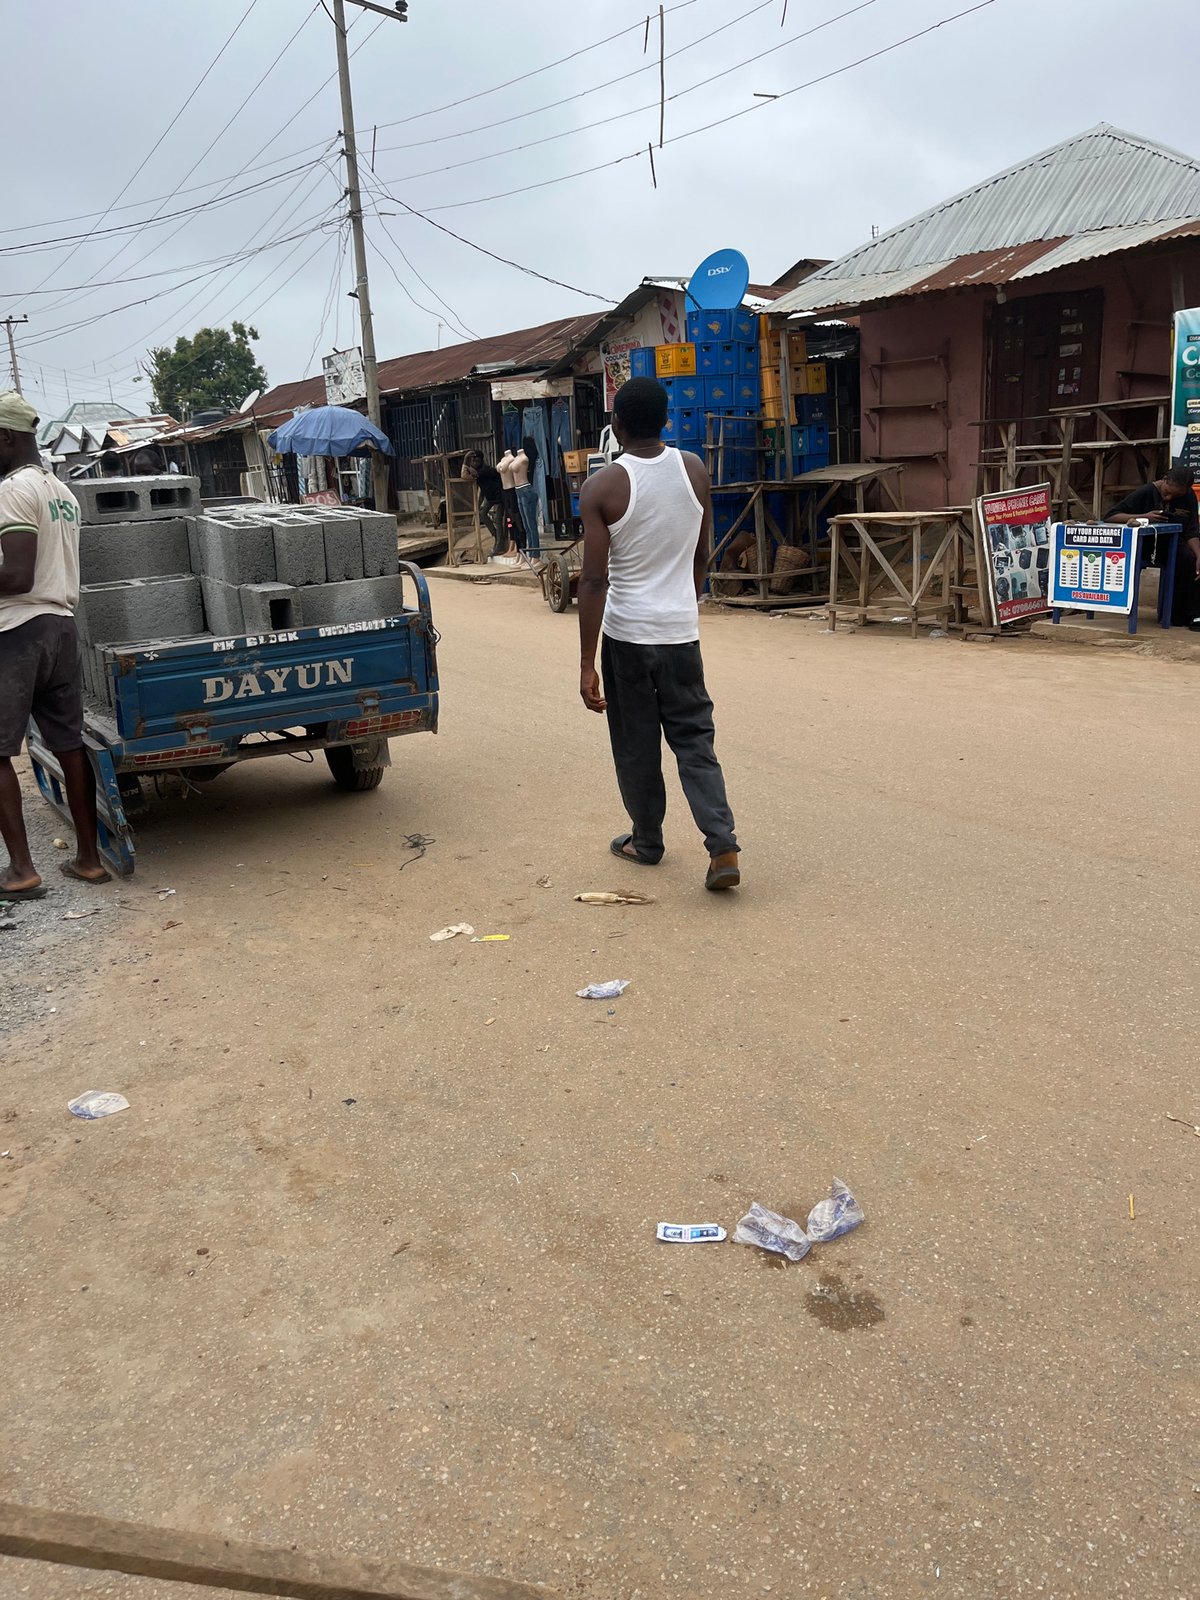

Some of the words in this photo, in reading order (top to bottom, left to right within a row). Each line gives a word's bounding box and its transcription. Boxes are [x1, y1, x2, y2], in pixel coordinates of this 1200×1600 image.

[1067, 527, 1077, 535] BUY
[1093, 528, 1121, 536] RECHARGE
[1073, 535, 1087, 543] CARD
[1072, 591, 1082, 599] POS
[1083, 592, 1110, 601] AVAILABLE
[246, 631, 299, 647] BLOCK
[202, 657, 354, 704] DAYUN
